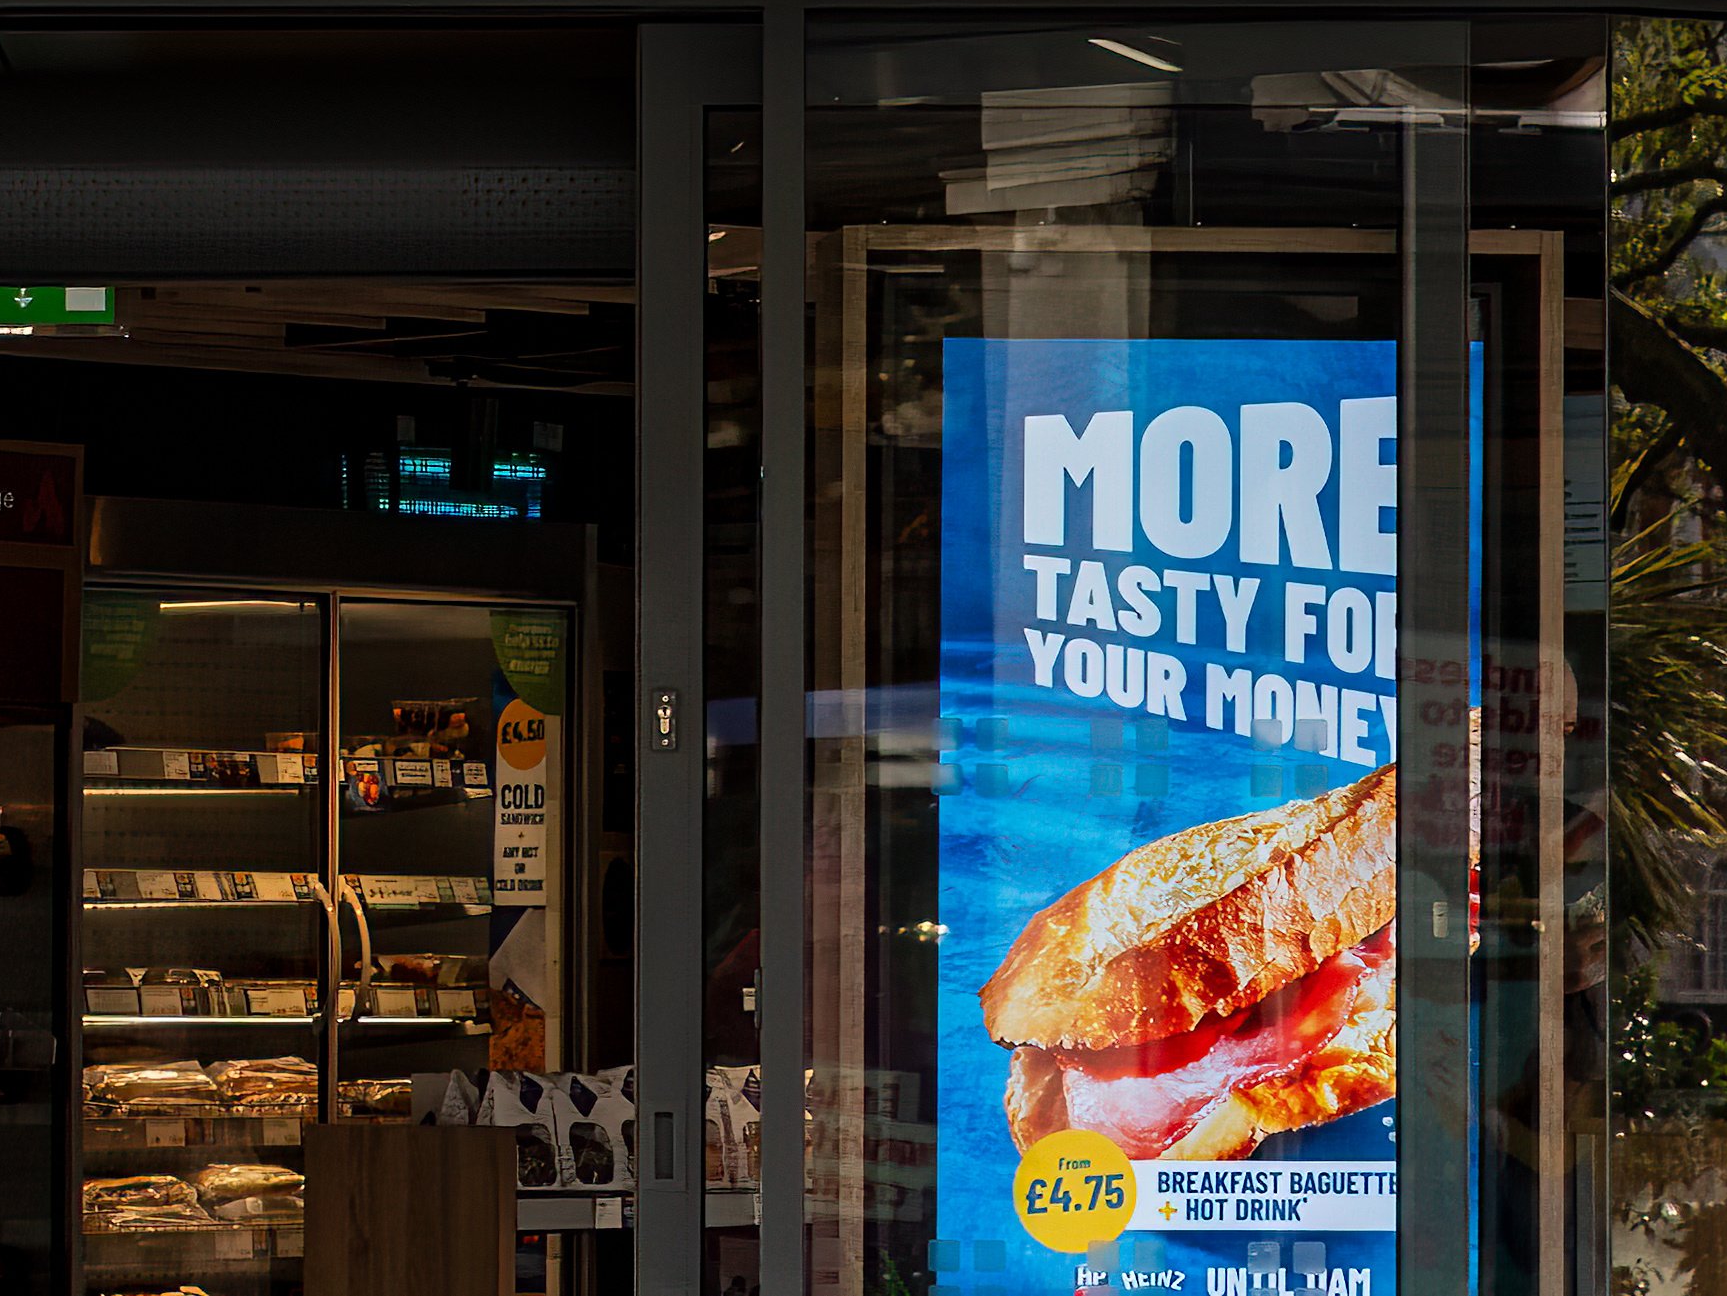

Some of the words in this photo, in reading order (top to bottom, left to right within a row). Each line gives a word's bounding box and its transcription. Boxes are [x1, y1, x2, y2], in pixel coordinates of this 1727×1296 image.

[1024, 395, 1397, 576] MORE
[1024, 554, 1260, 654] TASTY
[1024, 628, 1188, 722] YOUR
[501, 719, 545, 745] £4.50
[501, 783, 545, 809] COLD
[1058, 1157, 1091, 1170] From
[1026, 1174, 1124, 1215] £4.75
[1157, 1171, 1283, 1195] BREAKFAST
[1290, 1171, 1397, 1195] BAGUETTE
[1186, 1198, 1229, 1221] HOT
[1121, 1269, 1186, 1291] HEINZ
